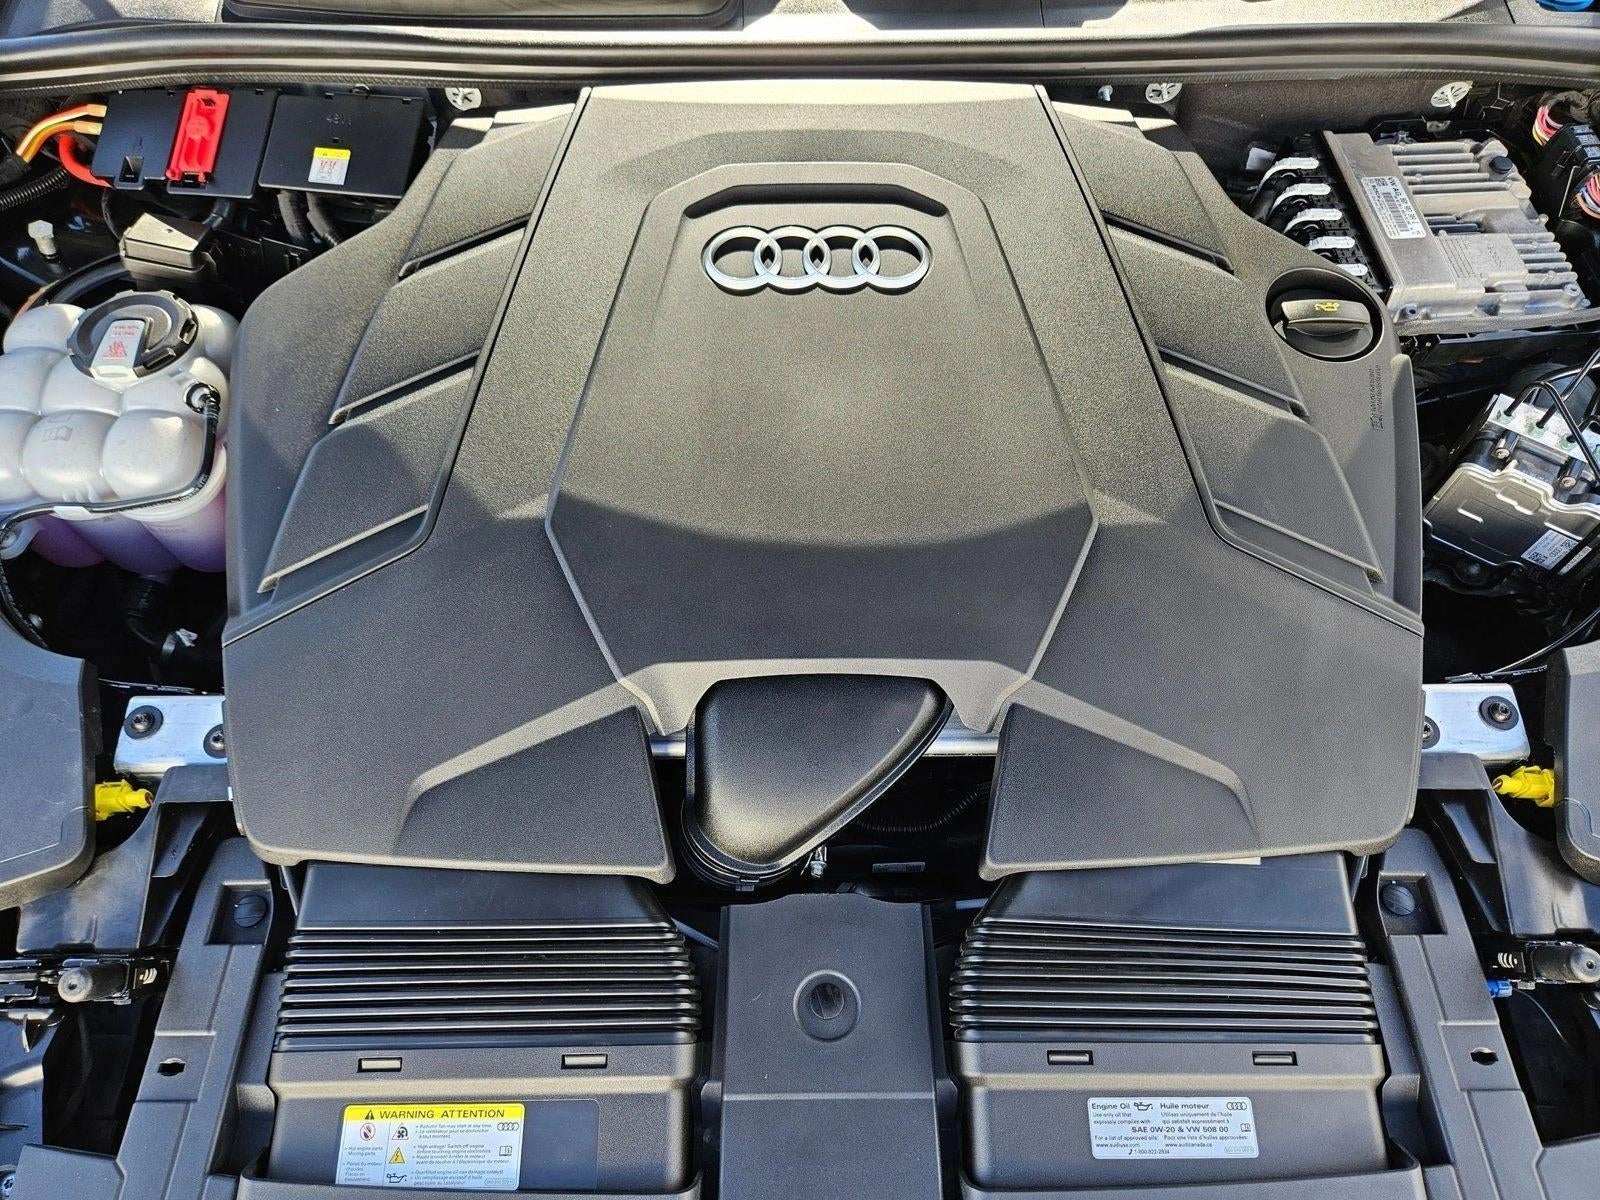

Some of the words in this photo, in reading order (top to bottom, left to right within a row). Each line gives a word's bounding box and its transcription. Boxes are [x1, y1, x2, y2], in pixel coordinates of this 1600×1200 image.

[1091, 1103, 1118, 1111] Engine
[379, 1110, 435, 1119] WARNING
[440, 1109, 506, 1119] ATTENTION
